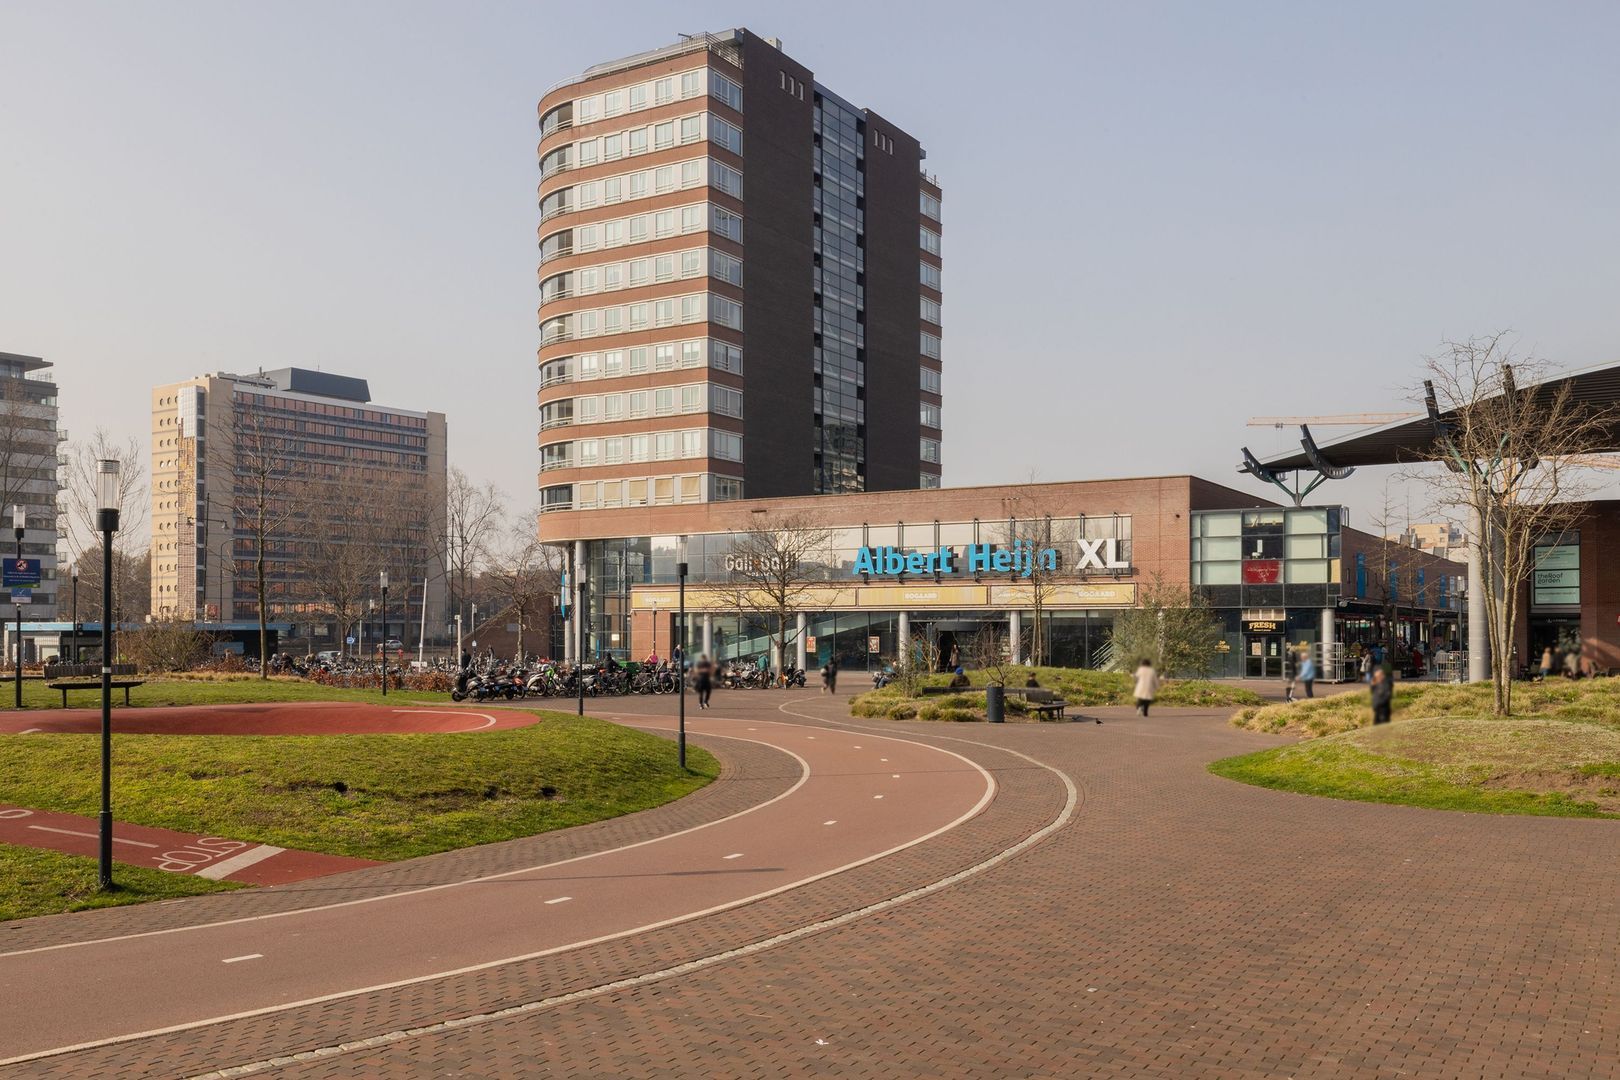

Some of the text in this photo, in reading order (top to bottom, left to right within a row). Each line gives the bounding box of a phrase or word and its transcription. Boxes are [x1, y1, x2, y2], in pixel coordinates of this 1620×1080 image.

[852, 538, 1129, 577] Albert Heijn XL
[151, 837, 247, 872] STOP
